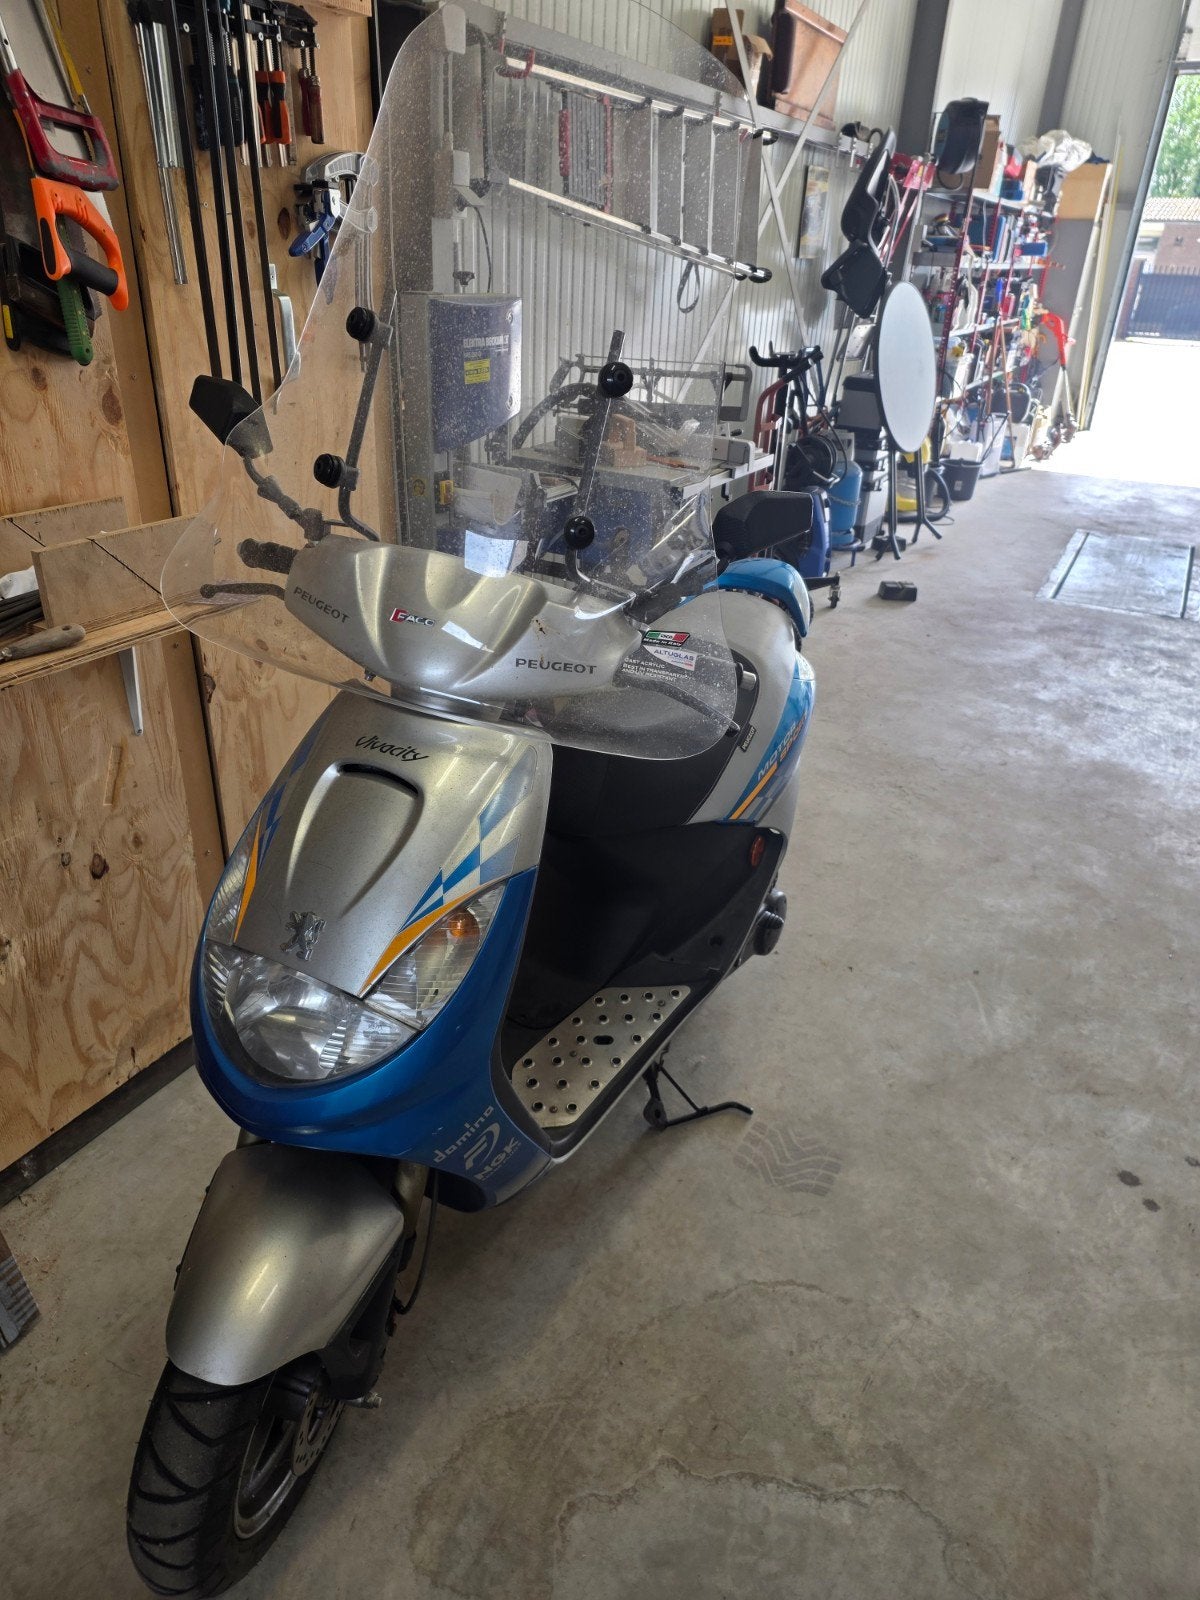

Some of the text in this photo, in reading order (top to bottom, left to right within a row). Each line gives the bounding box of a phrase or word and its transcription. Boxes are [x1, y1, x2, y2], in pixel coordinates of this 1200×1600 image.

[293, 587, 350, 624] PEUGEOT
[391, 607, 436, 627] FACO
[641, 661, 666, 669] ACRYLIC
[654, 649, 695, 661] ALTUGLAS
[515, 657, 597, 674] PEUGEOT
[433, 1105, 494, 1163] domino
[474, 1137, 519, 1180] NGK
